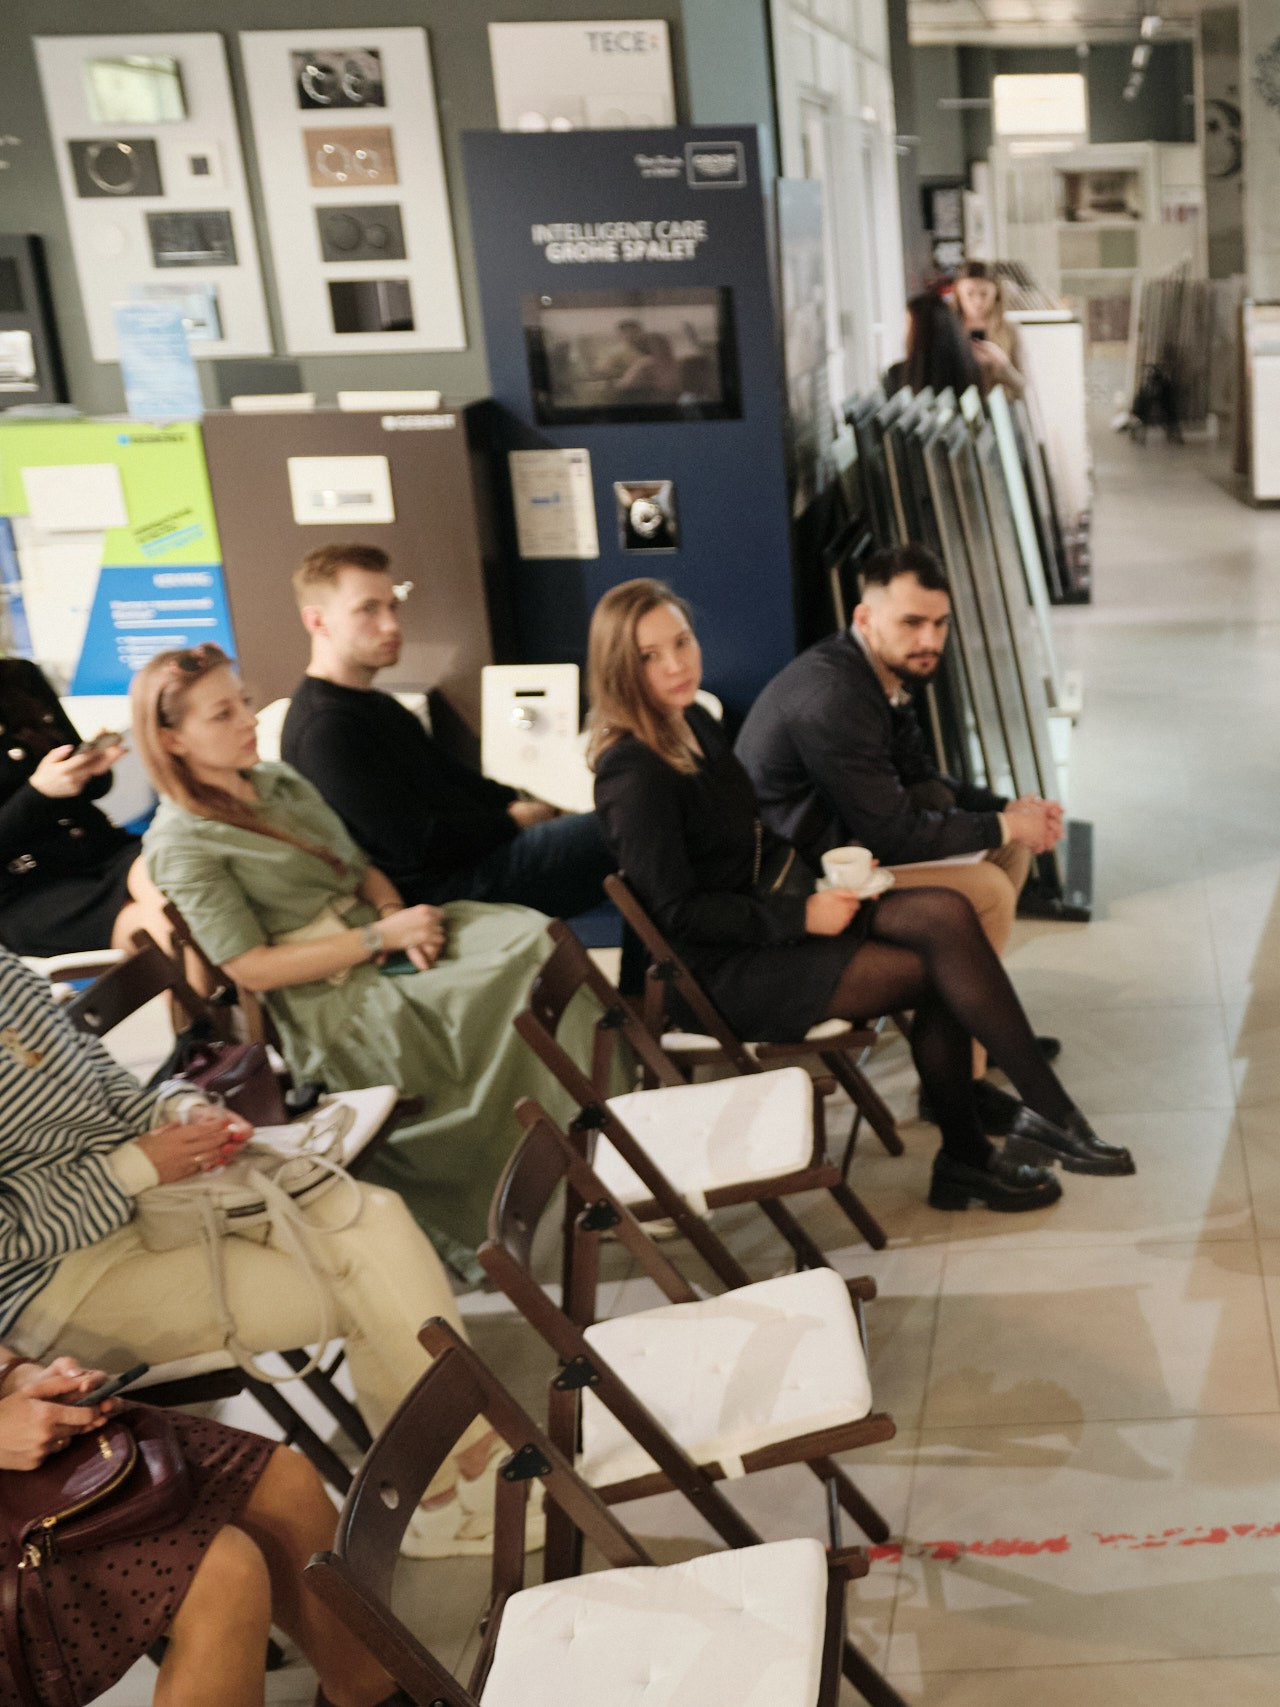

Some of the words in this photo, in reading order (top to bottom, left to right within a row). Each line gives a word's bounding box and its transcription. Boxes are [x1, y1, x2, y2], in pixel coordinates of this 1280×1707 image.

[531, 222, 654, 245] INTELLIGENT
[655, 220, 709, 241] CARE
[545, 241, 620, 264] GROHE
[621, 240, 697, 262] SPALET
